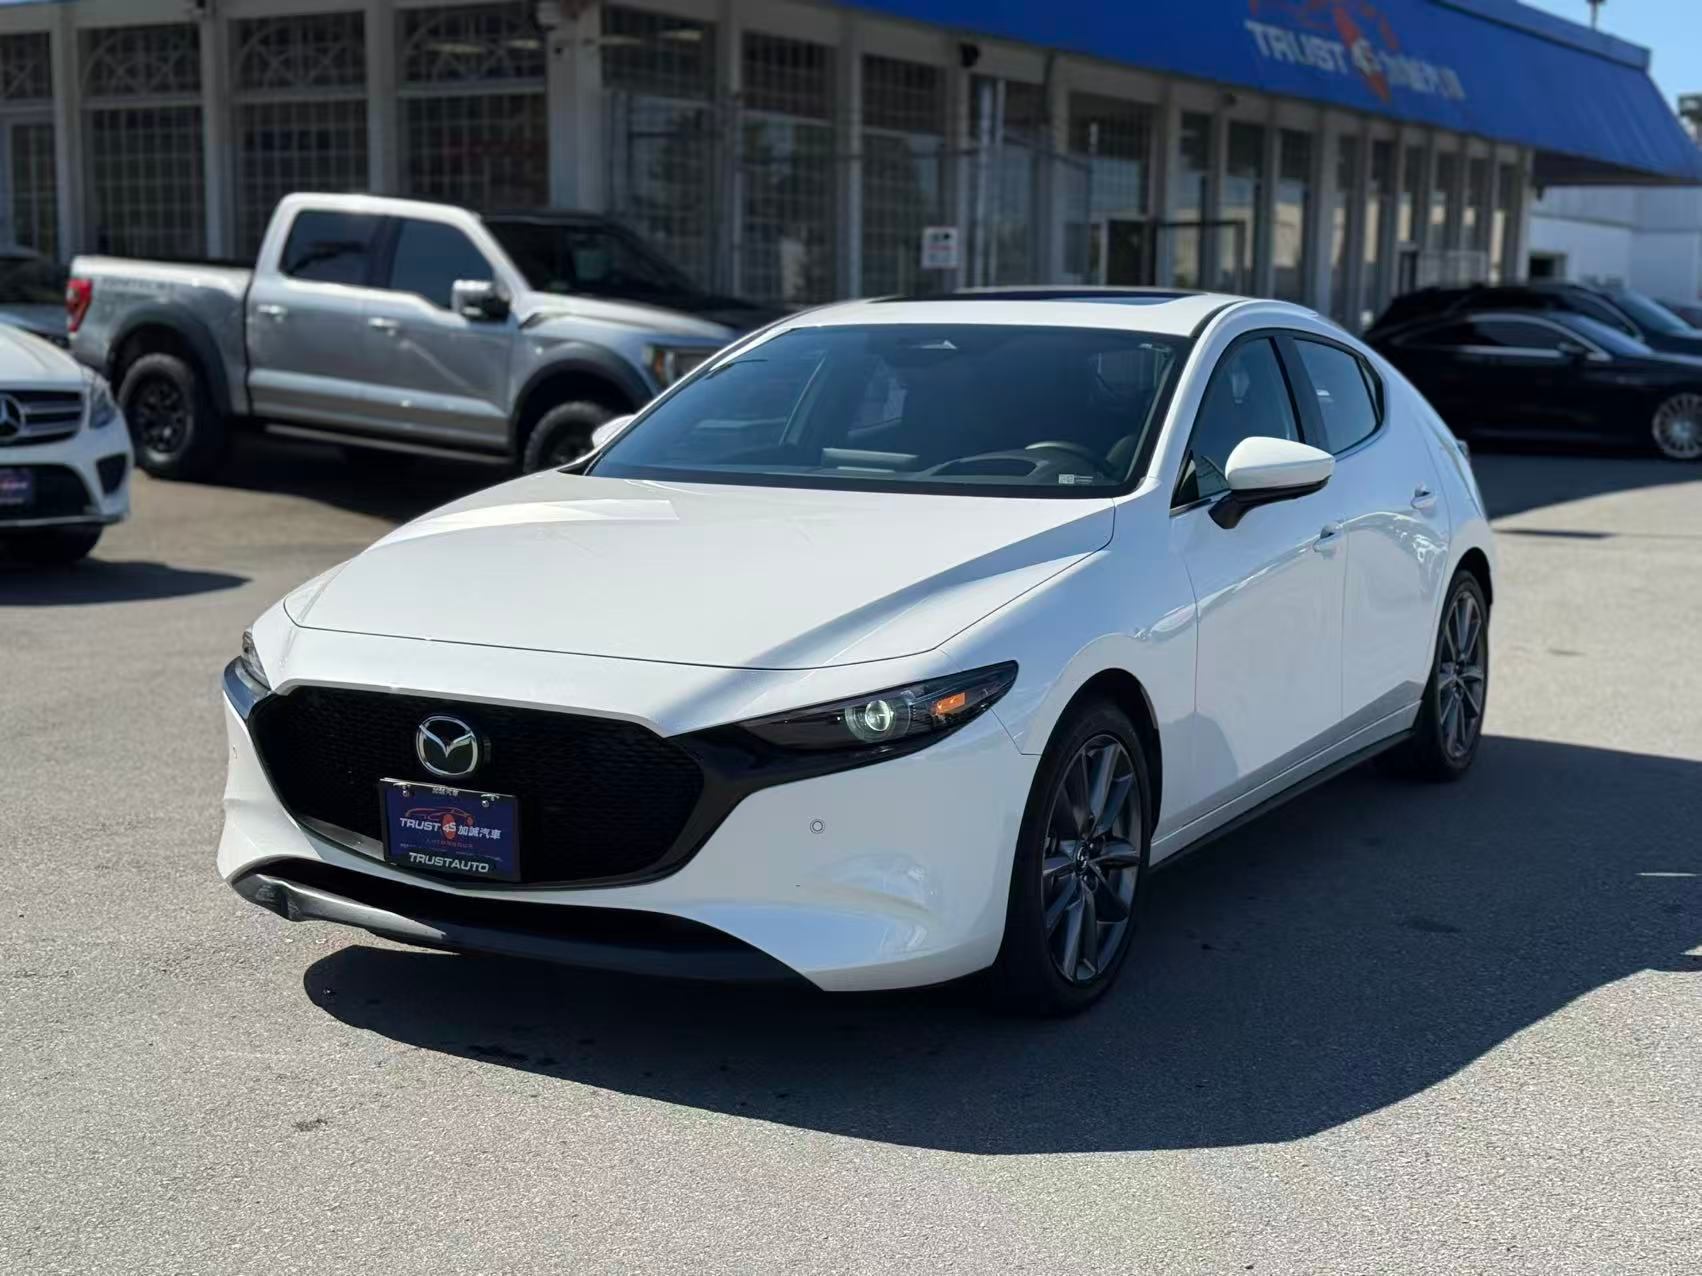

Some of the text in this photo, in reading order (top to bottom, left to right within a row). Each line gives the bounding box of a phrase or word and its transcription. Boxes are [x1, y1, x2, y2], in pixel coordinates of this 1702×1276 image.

[1244, 19, 1348, 75] TRUST
[400, 817, 441, 832] TRUST
[409, 852, 490, 873] TRUSTAUTO
